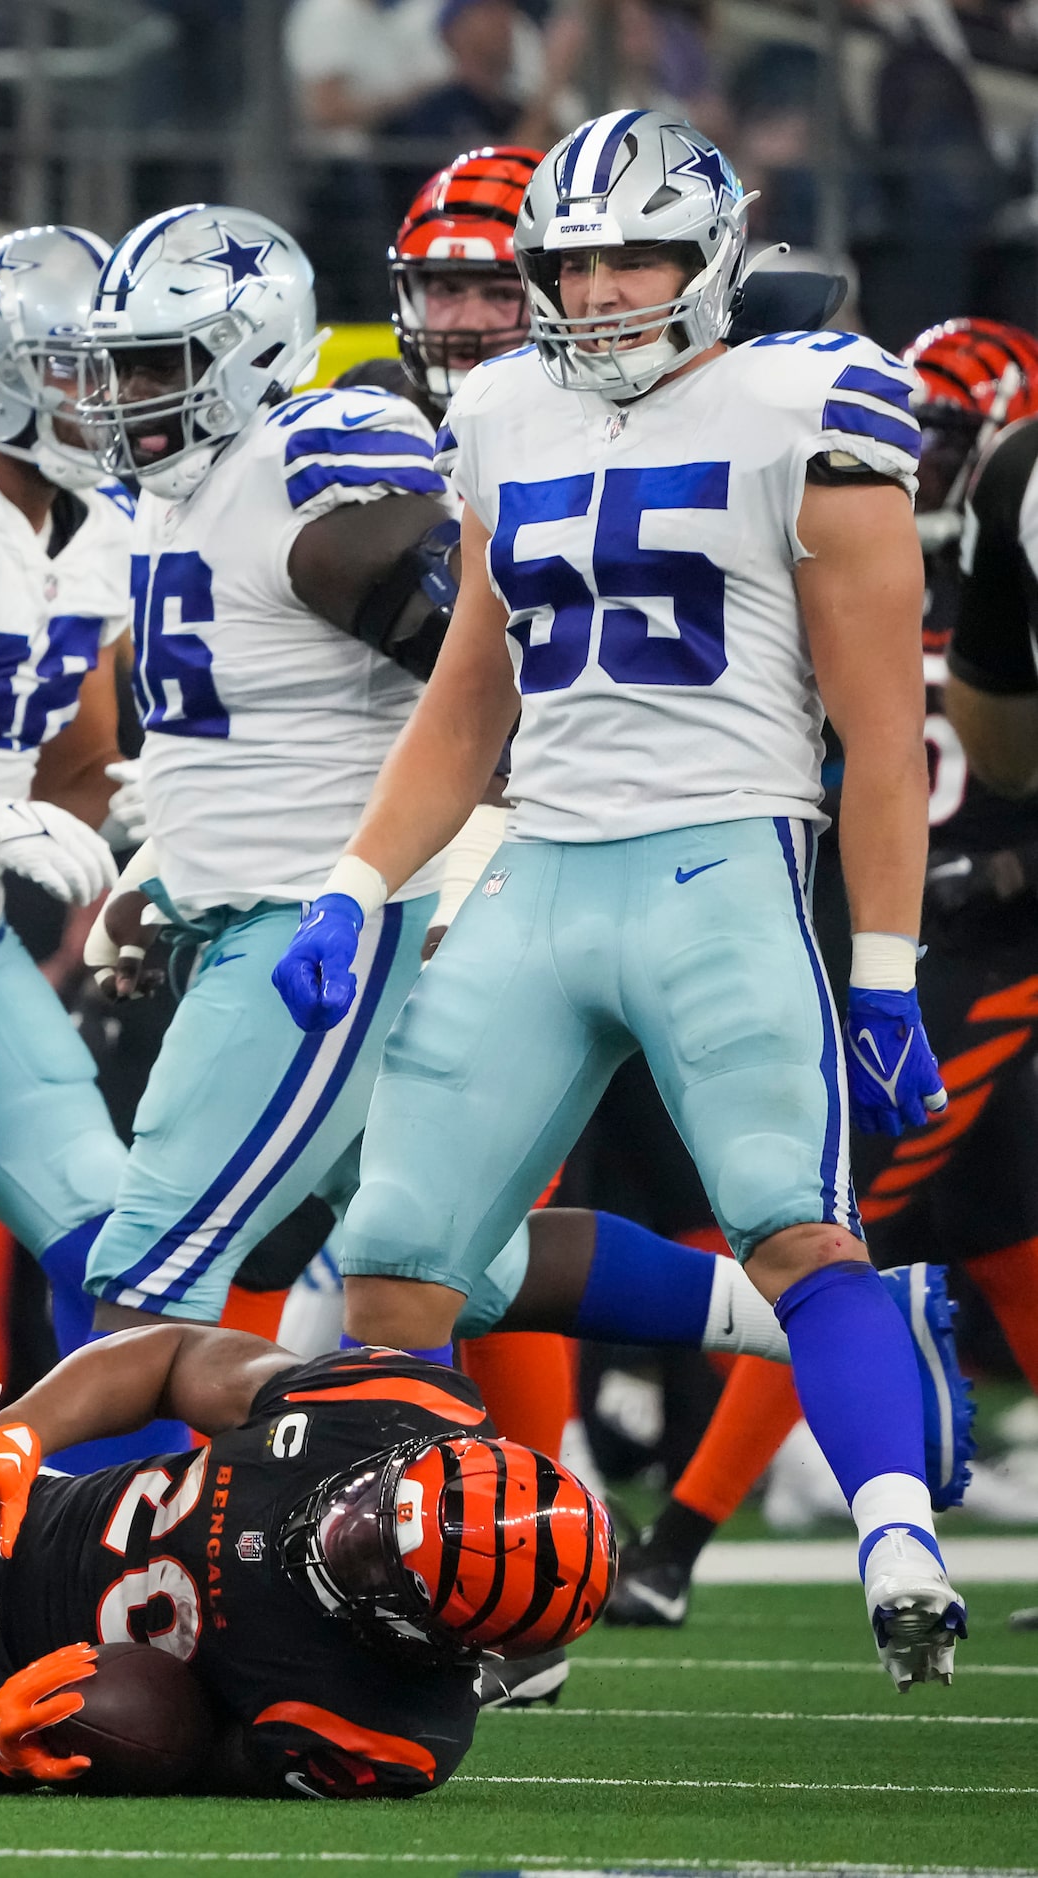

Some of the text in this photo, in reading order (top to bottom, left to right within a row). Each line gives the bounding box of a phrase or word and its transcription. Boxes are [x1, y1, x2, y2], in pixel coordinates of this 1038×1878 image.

[560, 223, 602, 234] COWBOYS
[490, 460, 731, 695] 55
[271, 1412, 309, 1459] C
[206, 1465, 233, 1629] BENGALS
